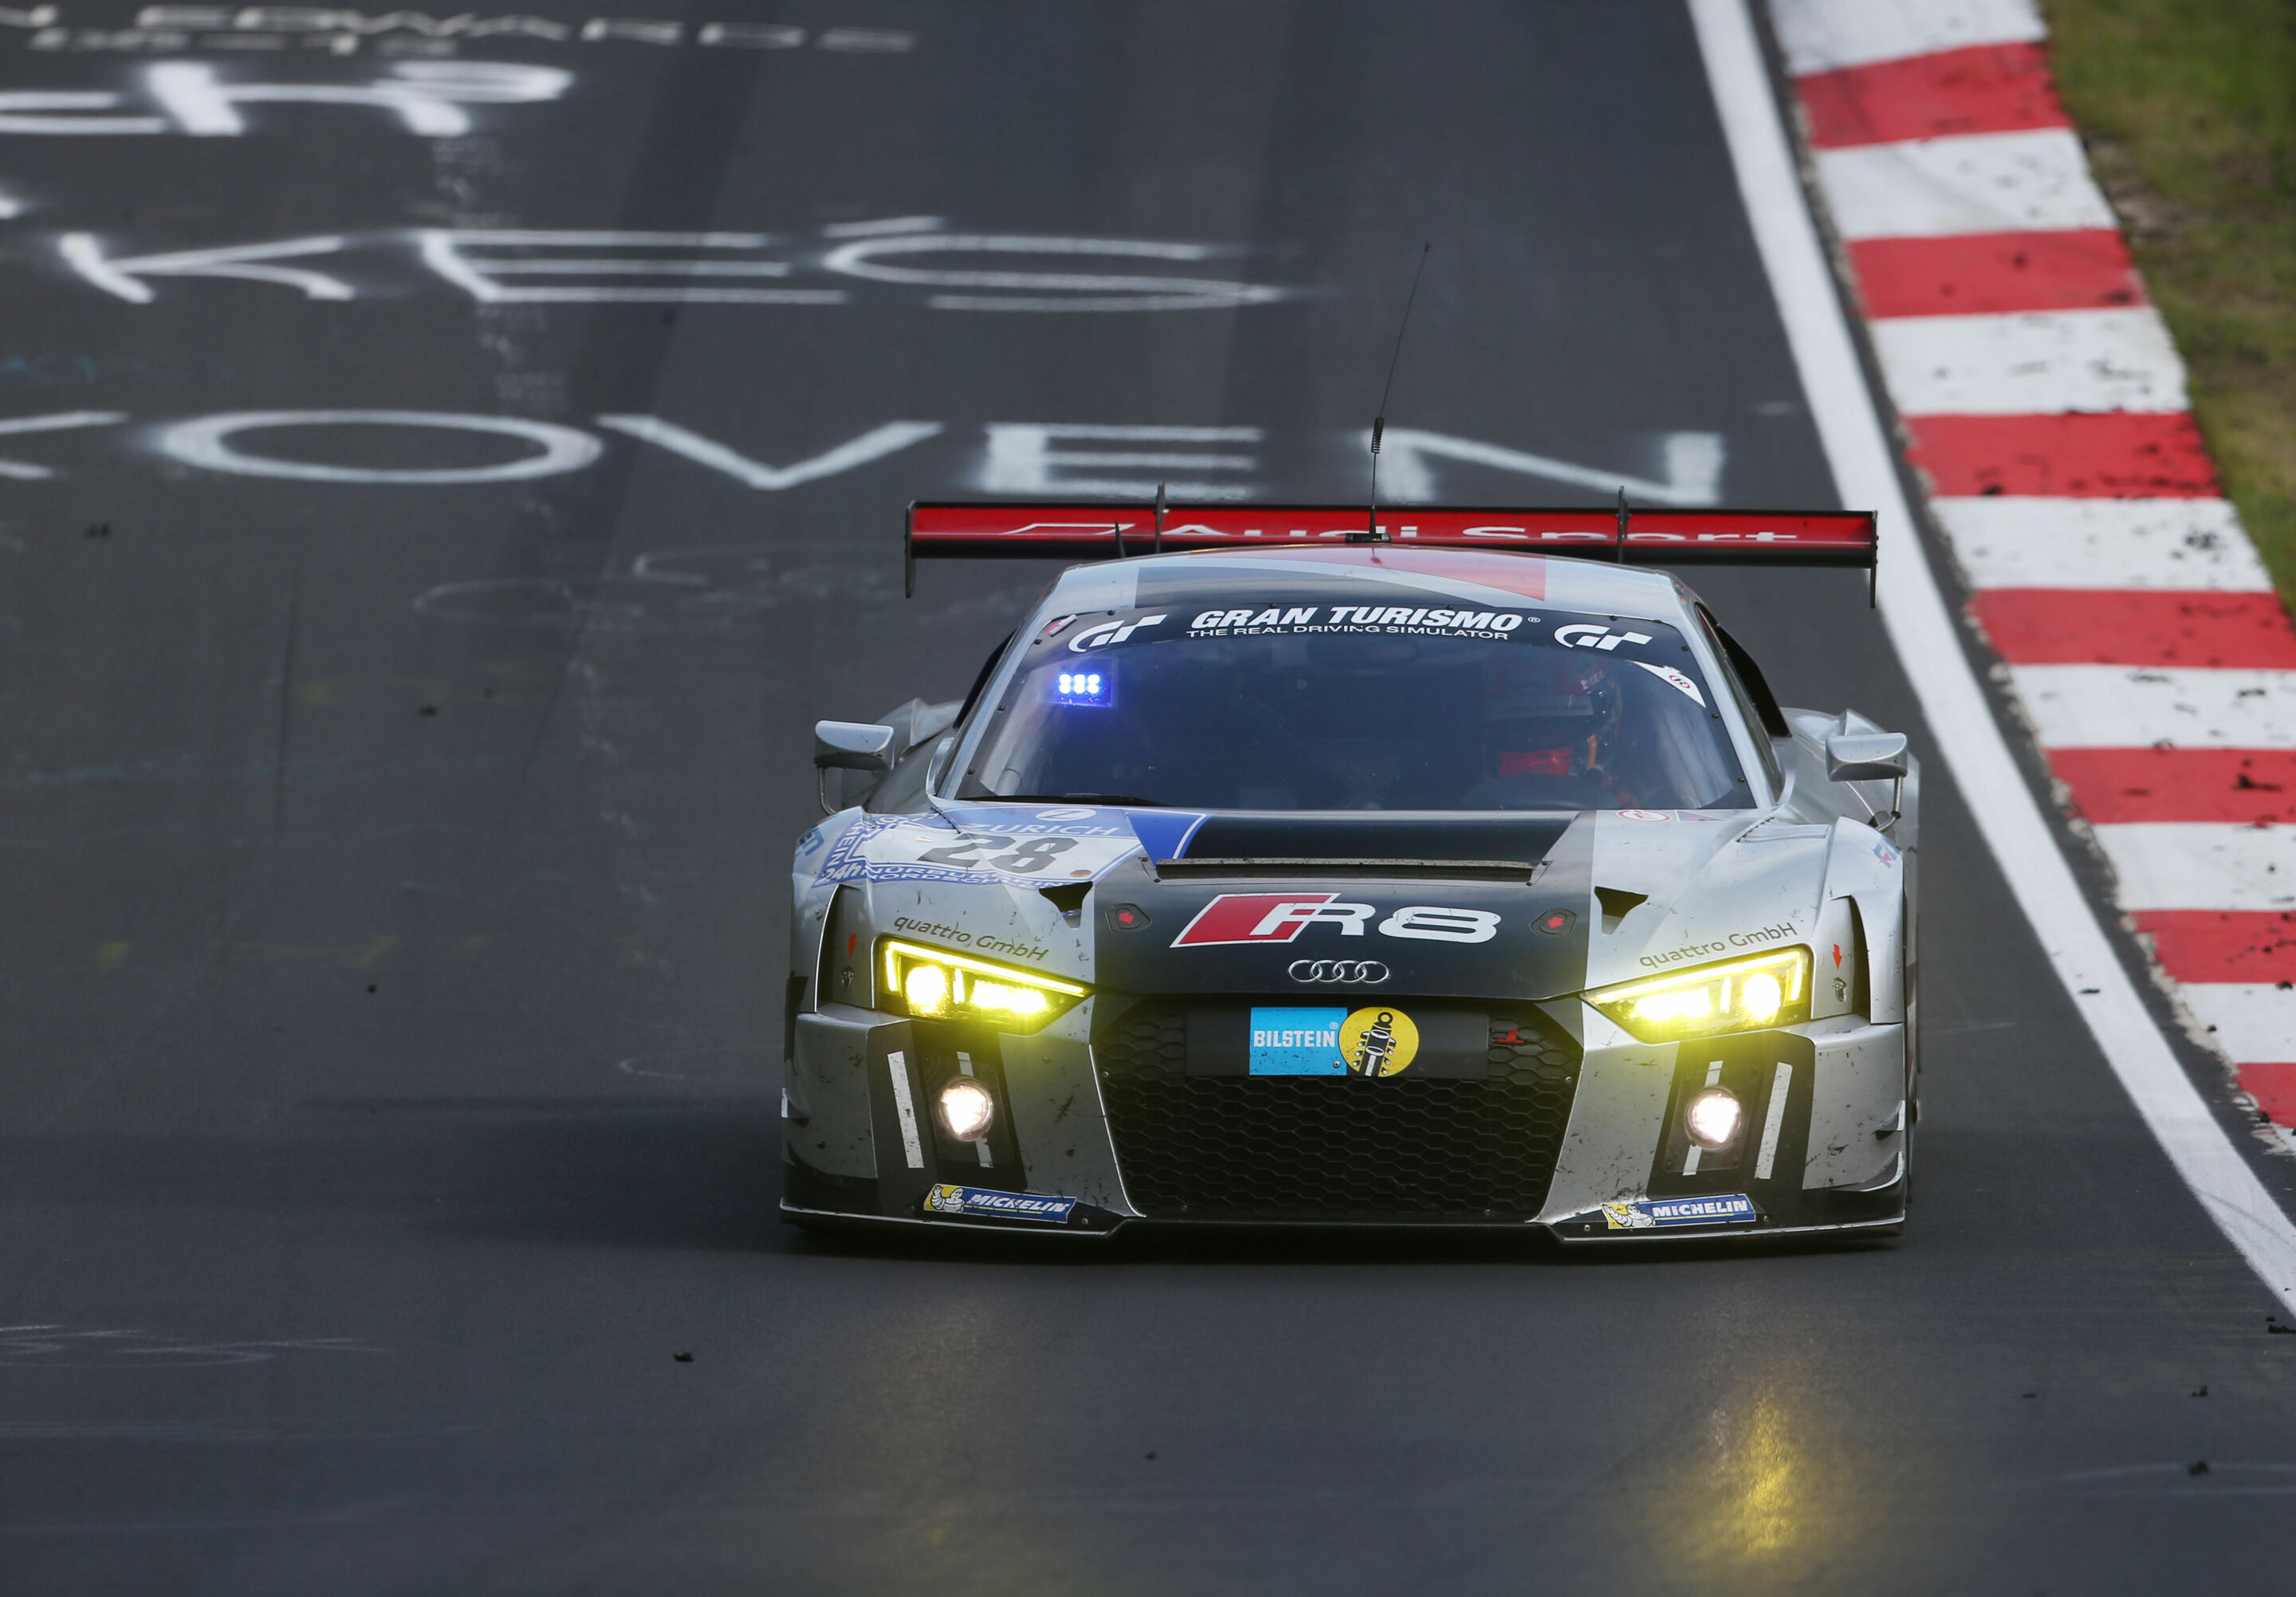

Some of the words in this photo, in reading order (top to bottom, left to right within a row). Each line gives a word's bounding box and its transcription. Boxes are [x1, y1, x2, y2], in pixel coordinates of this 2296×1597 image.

[1191, 607, 1318, 629] GRAN
[1329, 606, 1523, 631] TURISMO
[1186, 627, 1228, 638] THE
[1239, 626, 1288, 635] REAL
[1293, 625, 1380, 634] DRIVING
[1386, 626, 1508, 640] SIMULATOR
[957, 823, 1120, 836] ZURICH
[917, 832, 1079, 874] 28
[1249, 902, 1503, 944] R8
[893, 915, 971, 942] quattro
[975, 934, 1049, 962] GmbH
[1639, 941, 1726, 970] quattro
[1728, 922, 1799, 948] GmbH
[1252, 1030, 1336, 1048] BILSTEIN
[970, 1194, 1070, 1212] MICHELIN
[1653, 1200, 1748, 1217] MICHELIN
